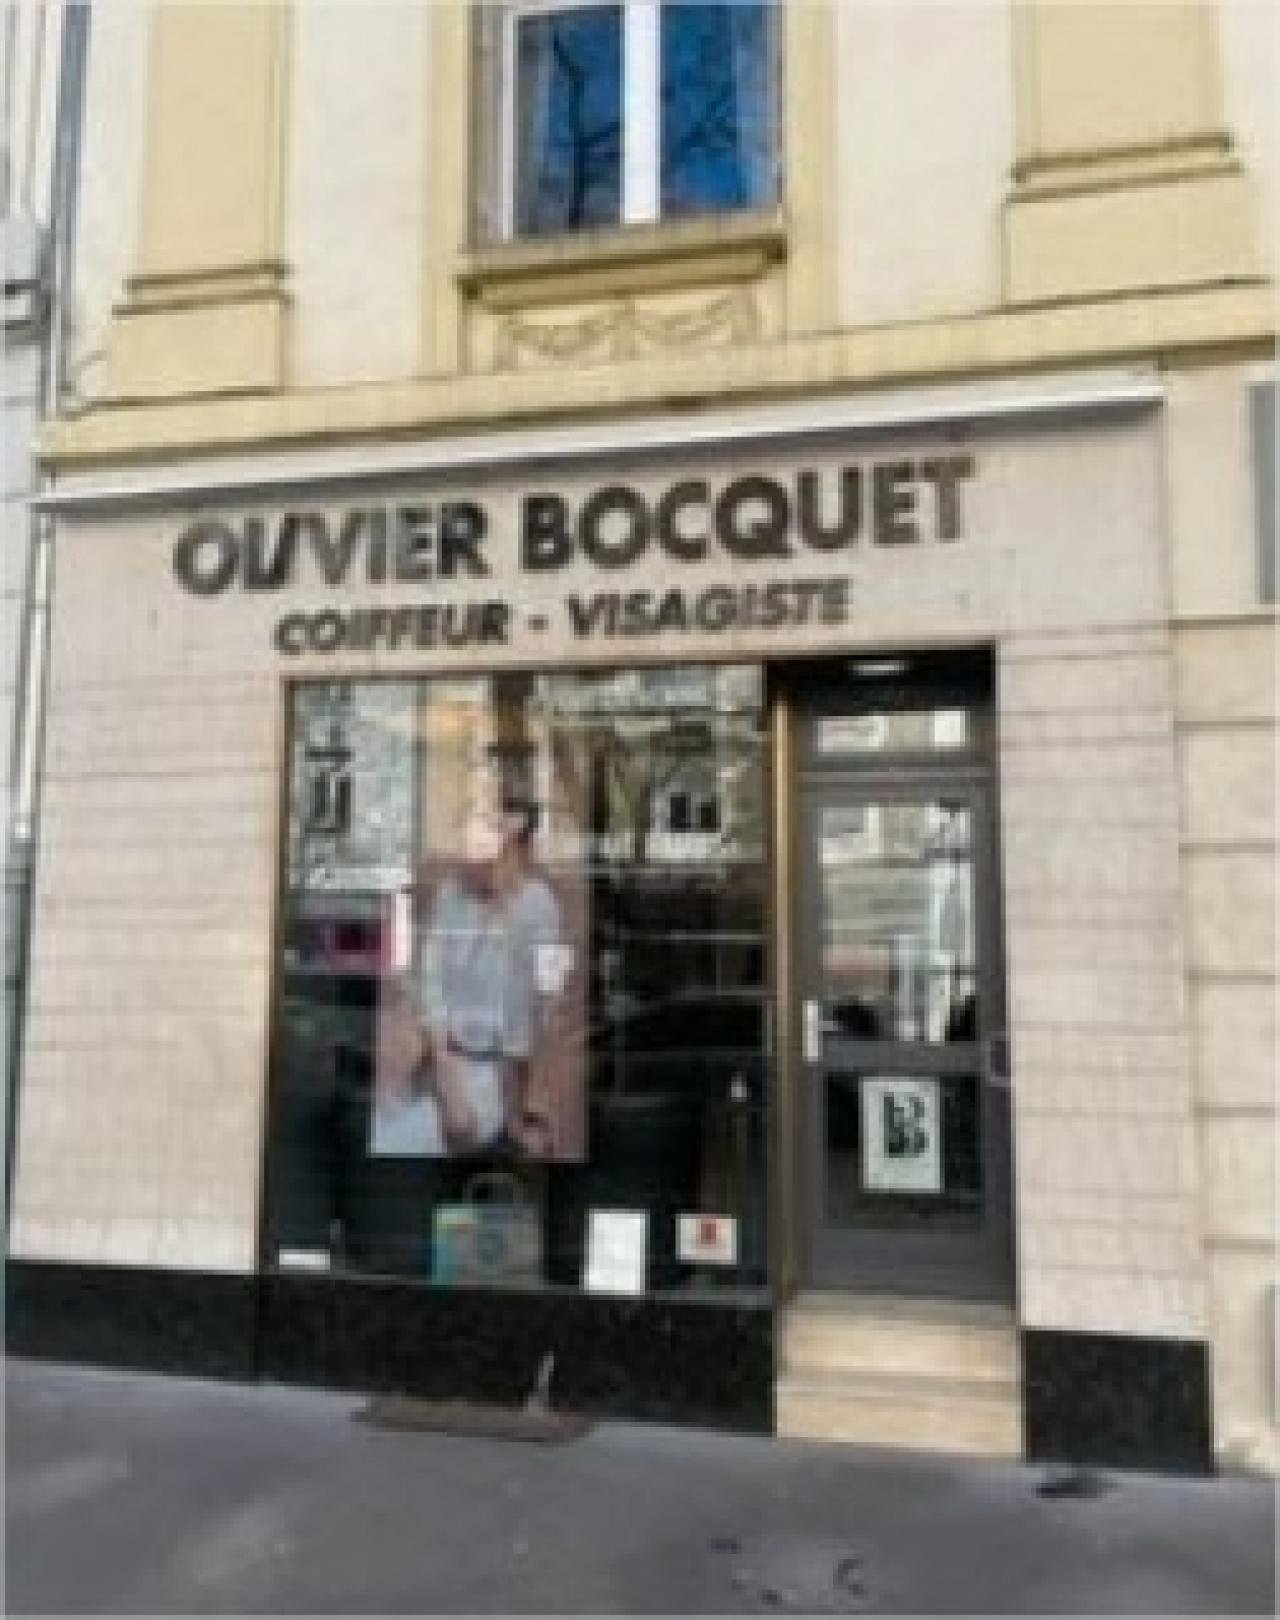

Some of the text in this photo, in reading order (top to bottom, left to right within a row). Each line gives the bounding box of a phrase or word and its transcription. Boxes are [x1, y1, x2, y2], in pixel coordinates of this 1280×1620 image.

[521, 457, 975, 571] BOCQUET
[274, 602, 511, 656] COIFFEUR
[567, 578, 852, 638] VISAGISTE
